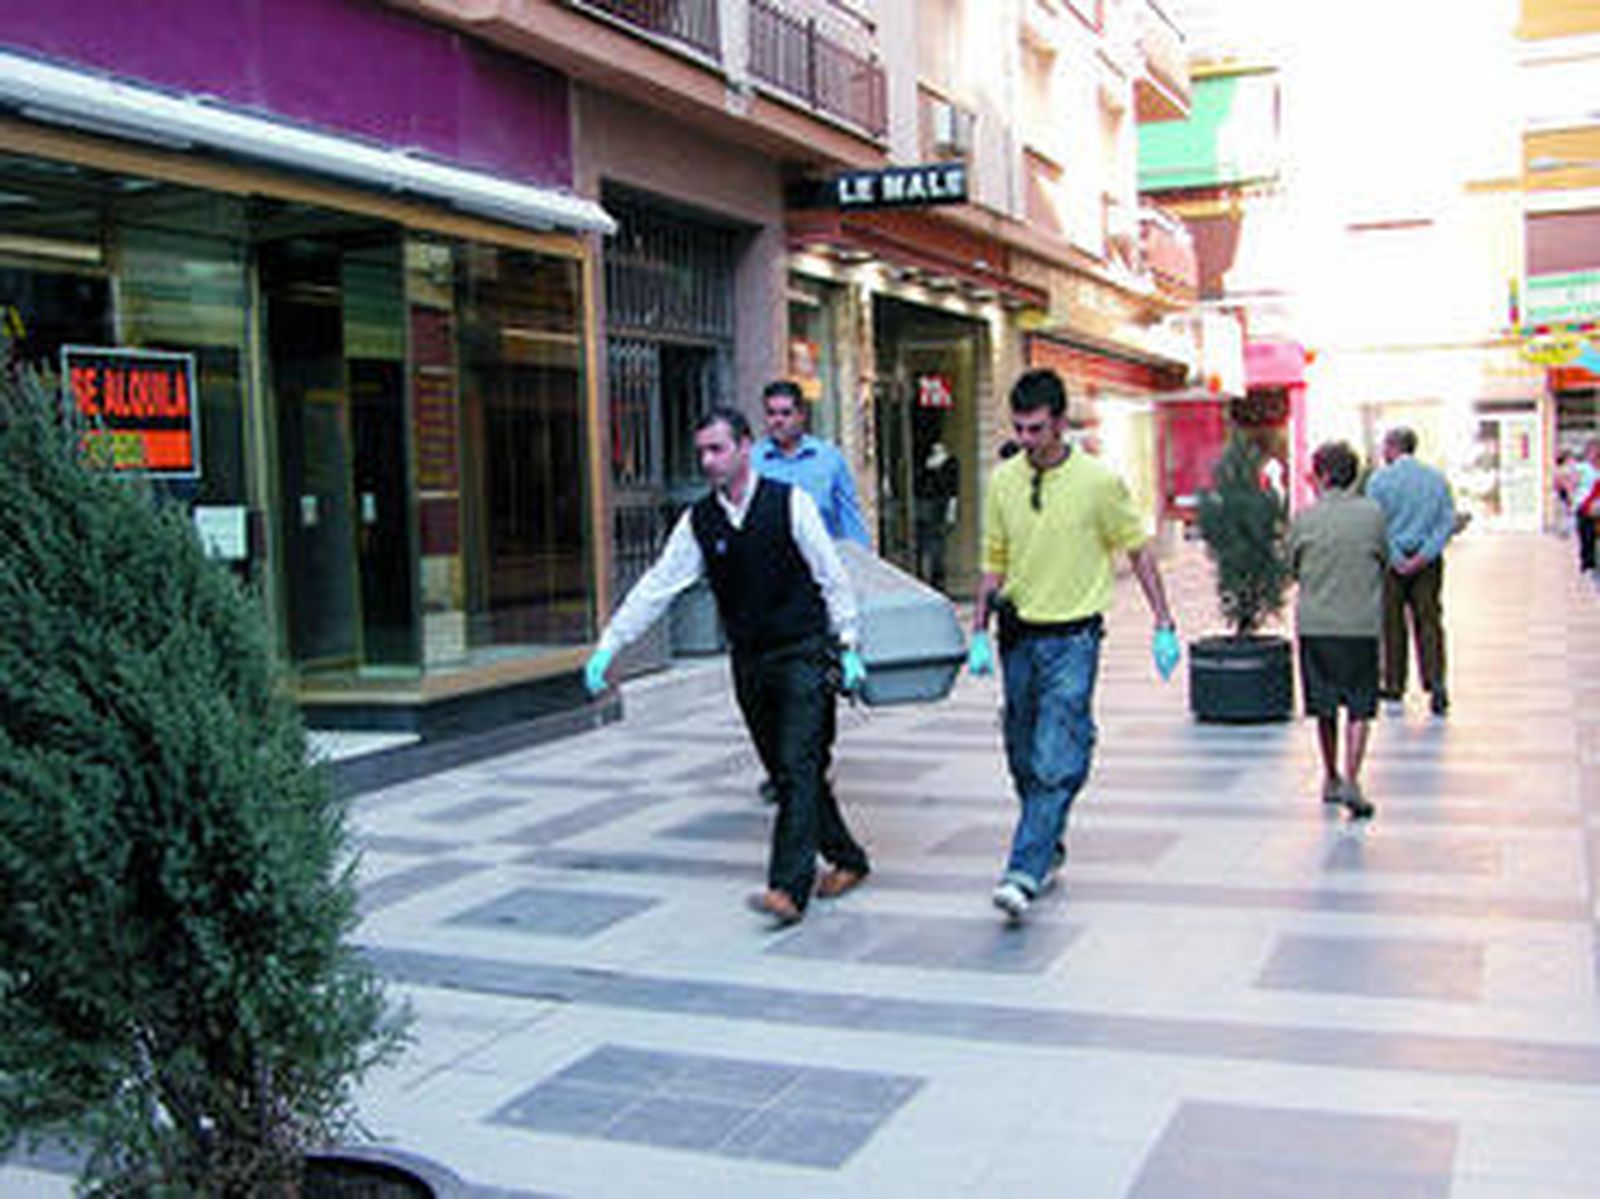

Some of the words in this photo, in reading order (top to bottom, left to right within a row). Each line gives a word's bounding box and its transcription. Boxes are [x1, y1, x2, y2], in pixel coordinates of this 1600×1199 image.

[839, 177, 875, 203] LE
[882, 170, 962, 201] MALE
[70, 366, 98, 415] SE
[103, 367, 190, 418] ALQUILA
